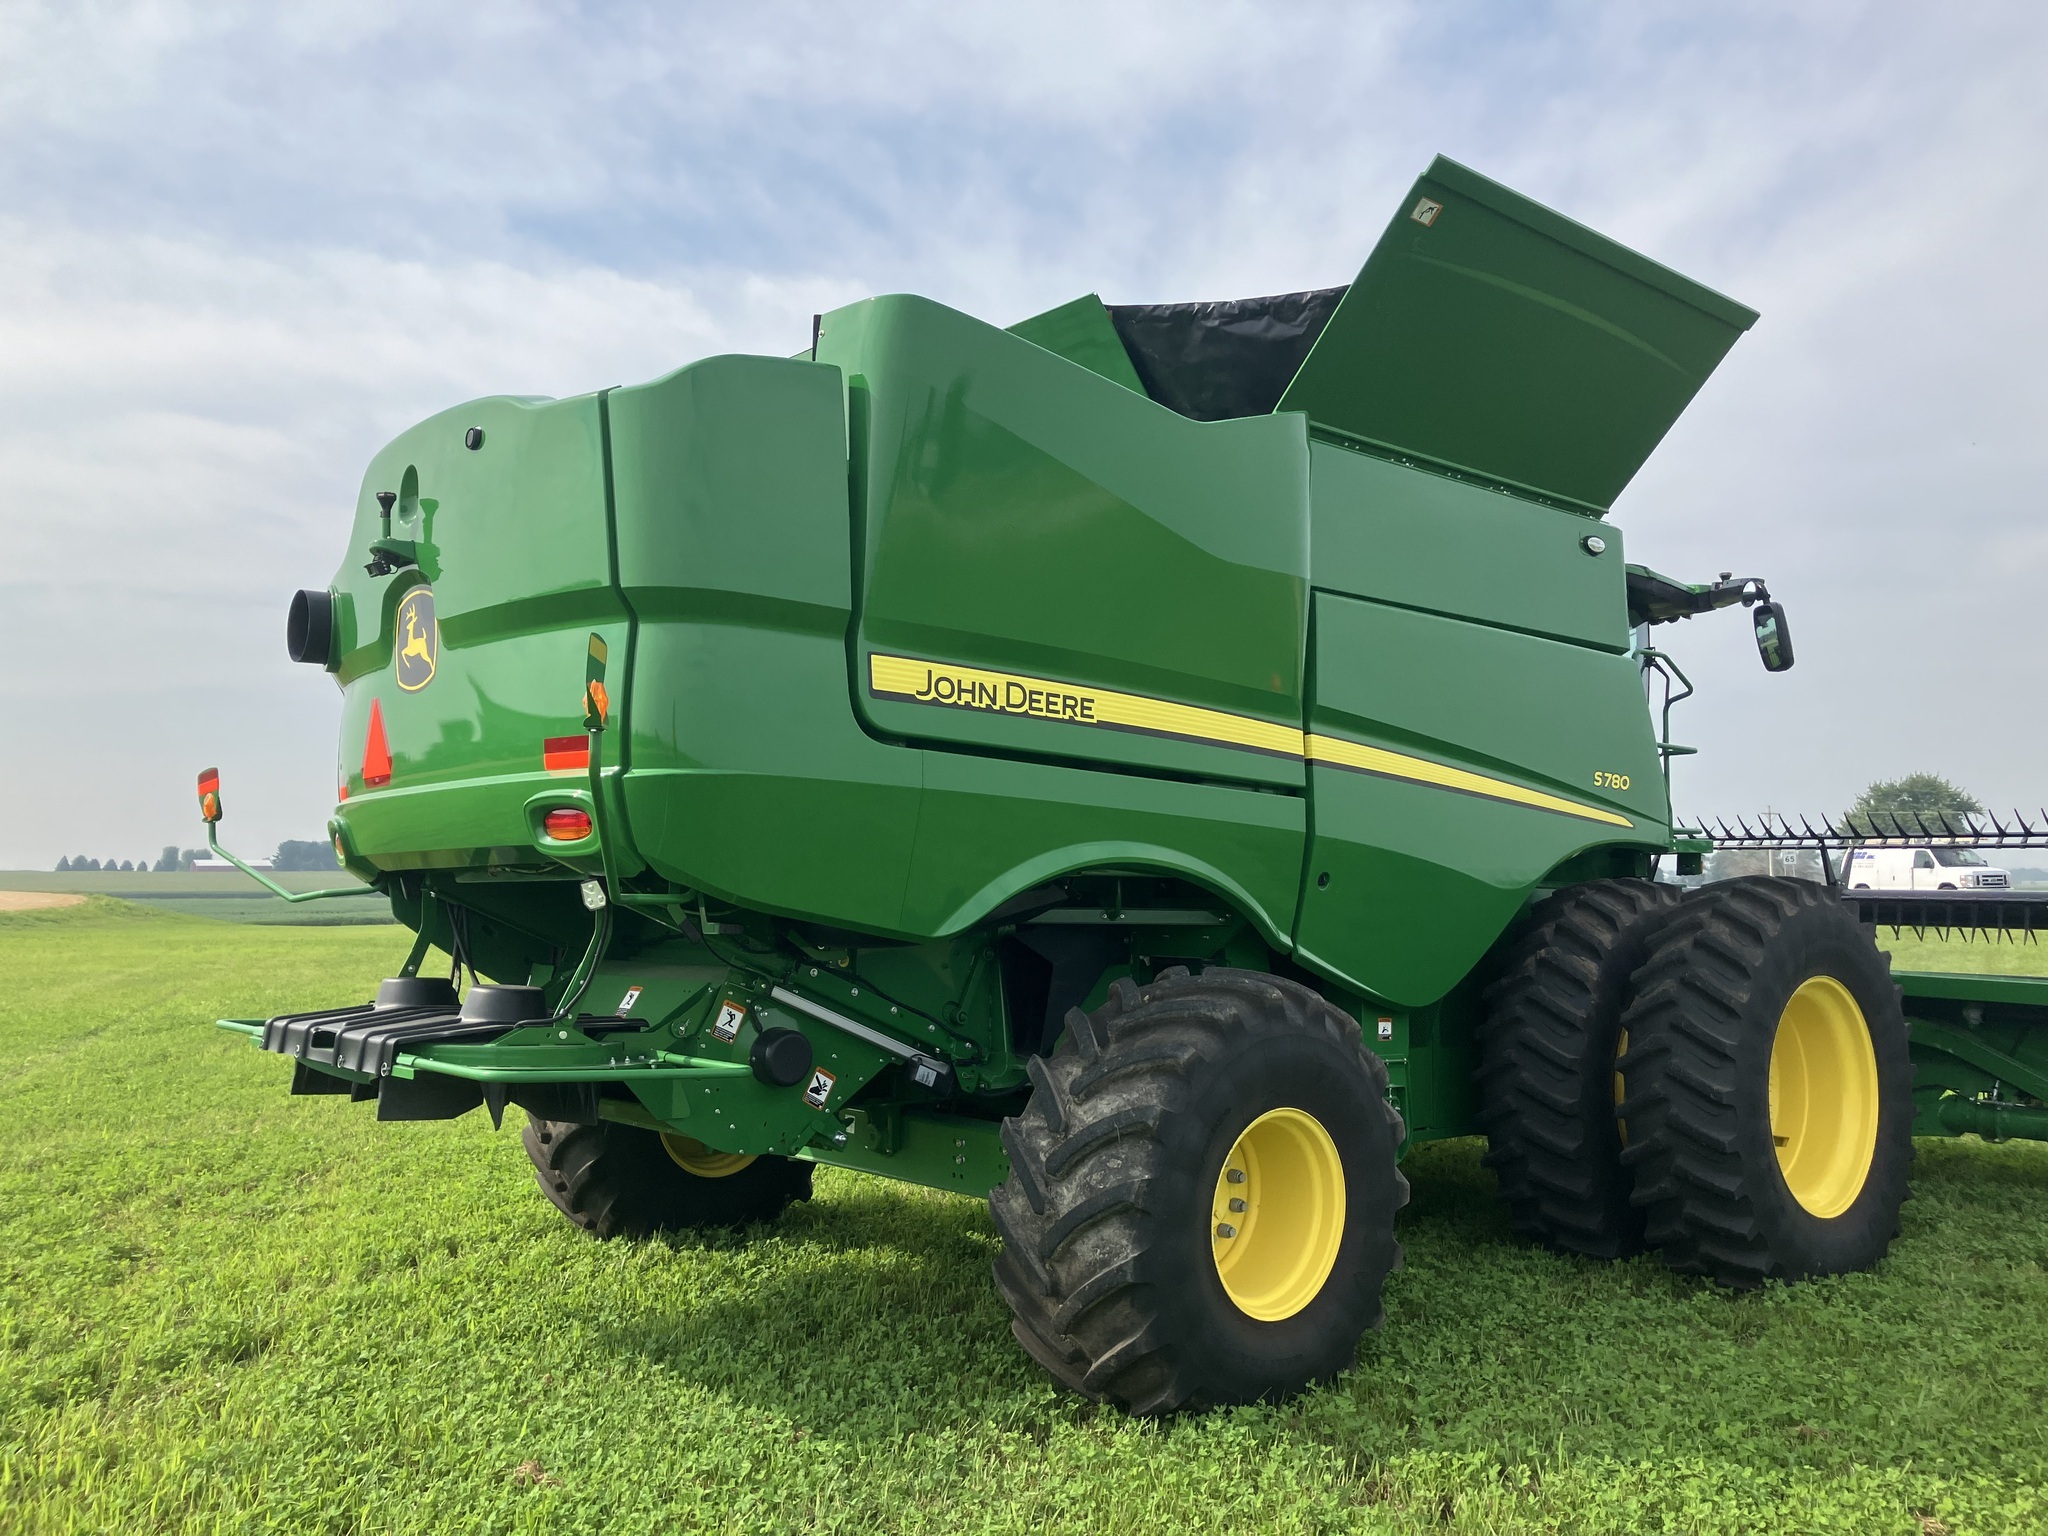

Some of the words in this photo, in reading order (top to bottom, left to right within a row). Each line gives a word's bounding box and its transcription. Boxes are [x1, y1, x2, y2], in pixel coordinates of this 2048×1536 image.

[915, 669, 997, 706] JOHN
[1005, 681, 1095, 720] DEERE
[1593, 771, 1630, 791] S780
[1785, 855, 1795, 863] 65
